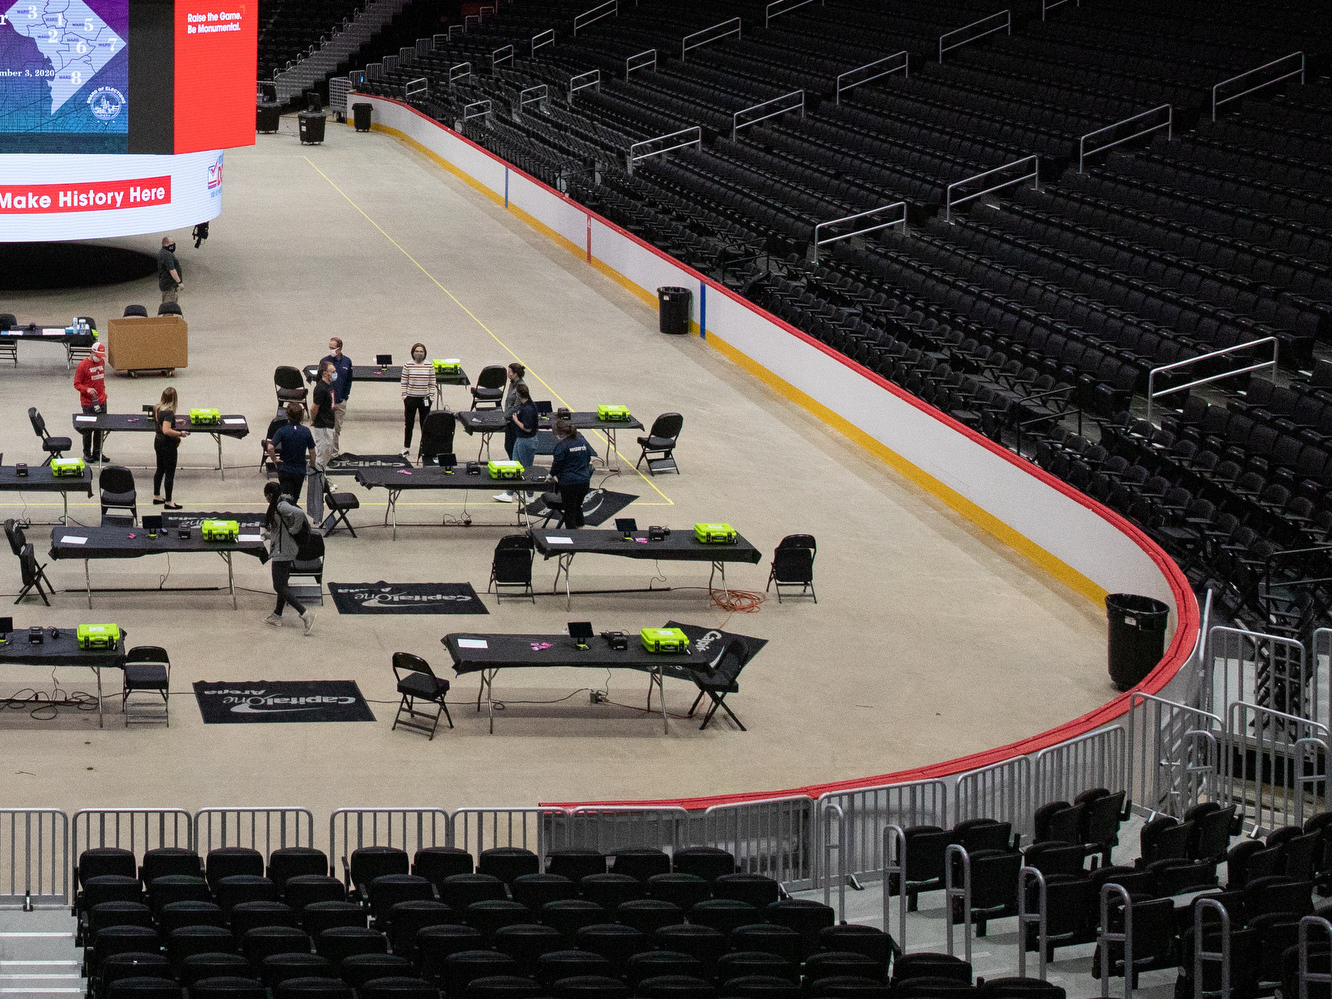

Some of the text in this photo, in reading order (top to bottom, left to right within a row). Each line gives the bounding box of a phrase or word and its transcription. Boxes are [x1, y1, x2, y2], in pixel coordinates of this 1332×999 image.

[27, 5, 38, 20] 3
[56, 13, 64, 26] 1
[188, 11, 242, 23] Raise the Game.
[83, 18, 94, 32] 5
[188, 21, 241, 34] Be Monumental.
[47, 28, 58, 43] 2
[75, 39, 87, 54] 6
[107, 37, 118, 52] 7
[25, 69, 33, 78] 3,
[35, 69, 55, 77] 2020
[70, 70, 82, 85] 8
[58, 189, 125, 208] History
[129, 185, 166, 203] Here
